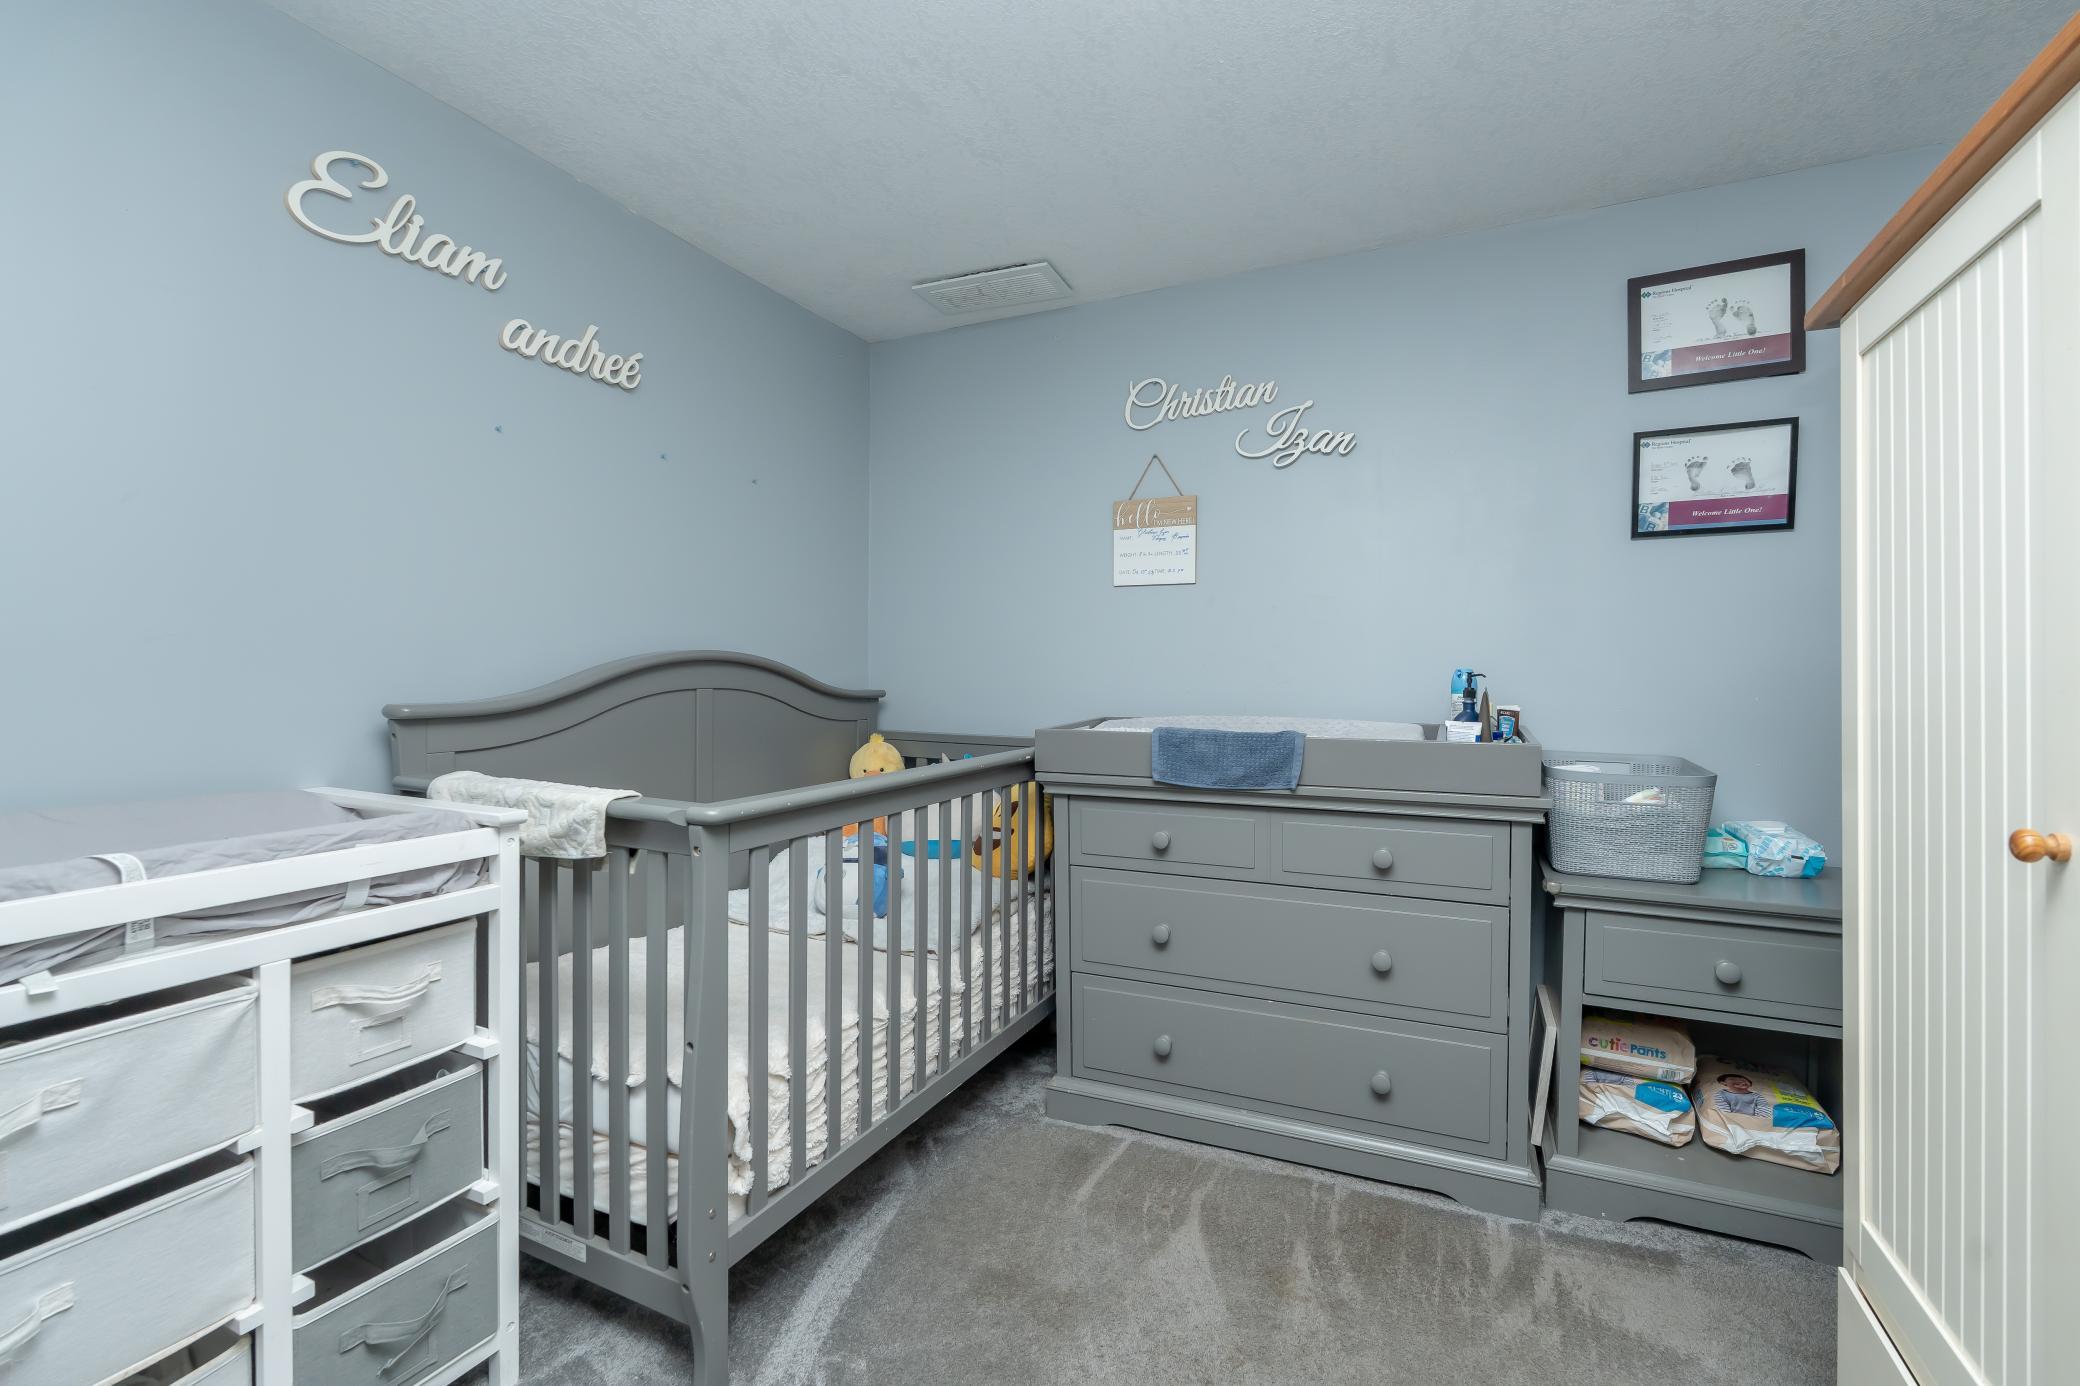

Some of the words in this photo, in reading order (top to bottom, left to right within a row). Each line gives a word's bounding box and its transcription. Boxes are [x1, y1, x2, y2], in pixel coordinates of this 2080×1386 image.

[284, 150, 508, 291] Eliam
[499, 318, 644, 390] andreé
[1695, 353, 1726, 362] Welcome
[1727, 349, 1747, 358] Little
[1748, 347, 1766, 355] One!
[1124, 374, 1279, 431] Christian
[1234, 400, 1358, 470] Izan
[1114, 499, 1161, 528] hello
[1692, 509, 1722, 517] Welcome
[1744, 506, 1763, 514] One!
[1630, 1043, 1667, 1059] Pants
